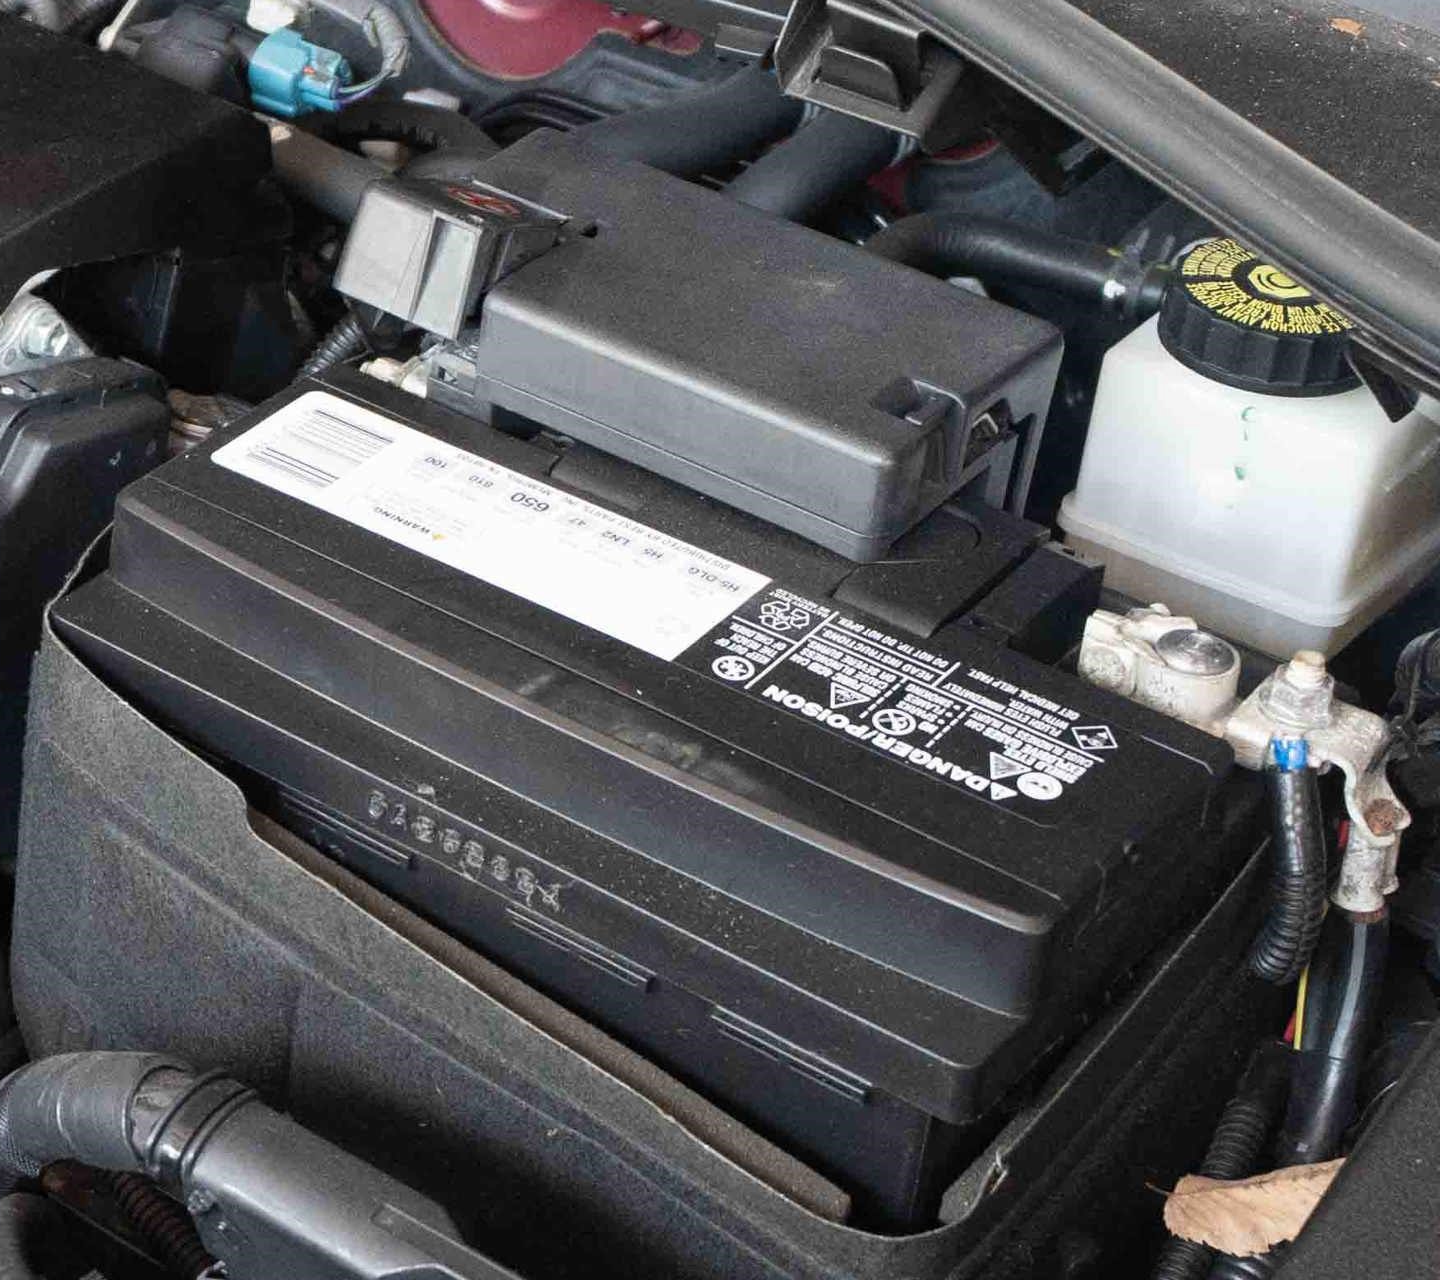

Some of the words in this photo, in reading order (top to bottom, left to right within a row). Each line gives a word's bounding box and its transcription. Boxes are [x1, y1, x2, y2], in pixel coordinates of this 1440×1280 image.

[1216, 303, 1258, 326] AVANT
[1232, 303, 1266, 320] FREIN
[1247, 299, 1283, 314] BIDON
[1261, 319, 1321, 334] BOUCHON
[421, 455, 449, 469] 100
[506, 490, 552, 513] 650
[370, 505, 432, 534] WARNING
[762, 685, 990, 791] DANGER/POISON
